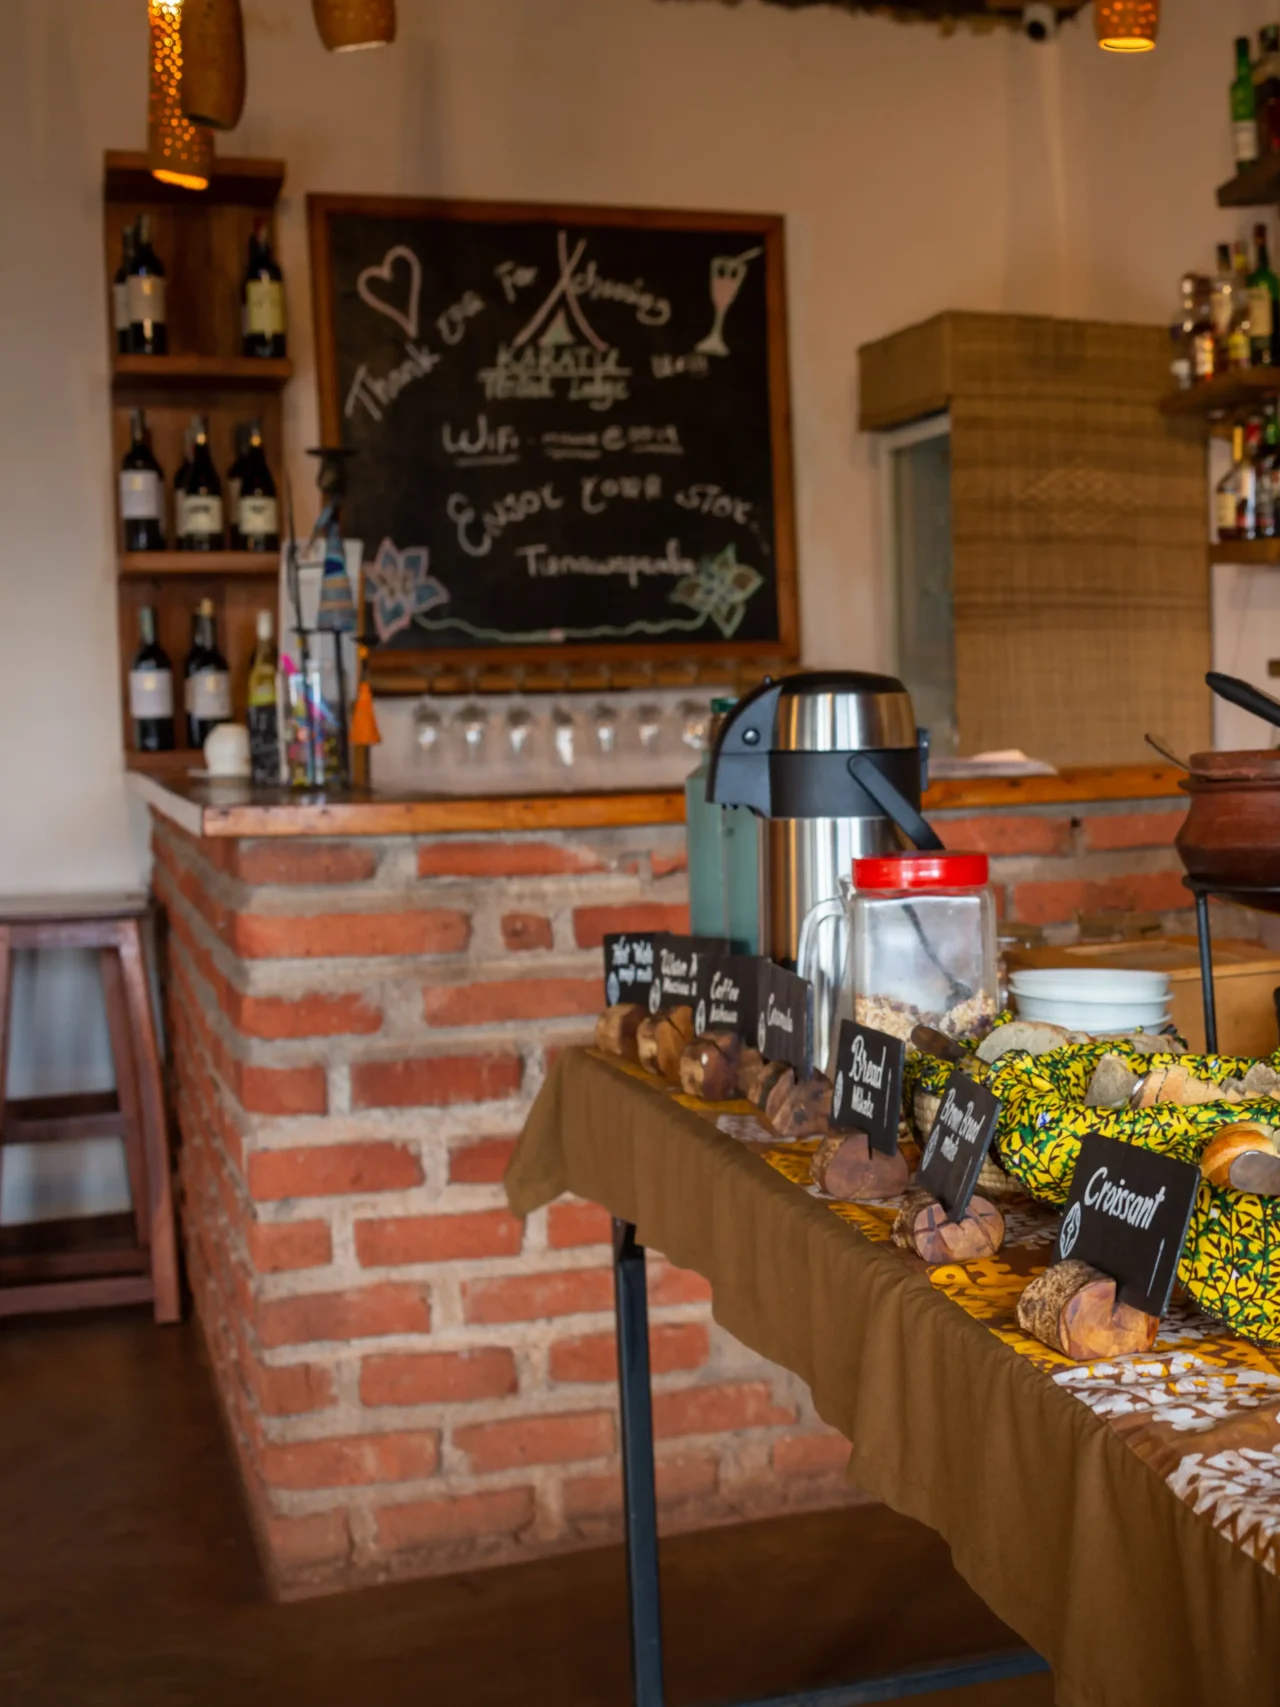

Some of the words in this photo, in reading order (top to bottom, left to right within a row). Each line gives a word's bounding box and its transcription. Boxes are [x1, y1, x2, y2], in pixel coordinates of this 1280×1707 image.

[709, 970, 740, 1003] Coffee
[848, 1034, 887, 1090] Bread
[959, 1101, 986, 1145] Bread
[1084, 1166, 1166, 1230] Croissant
